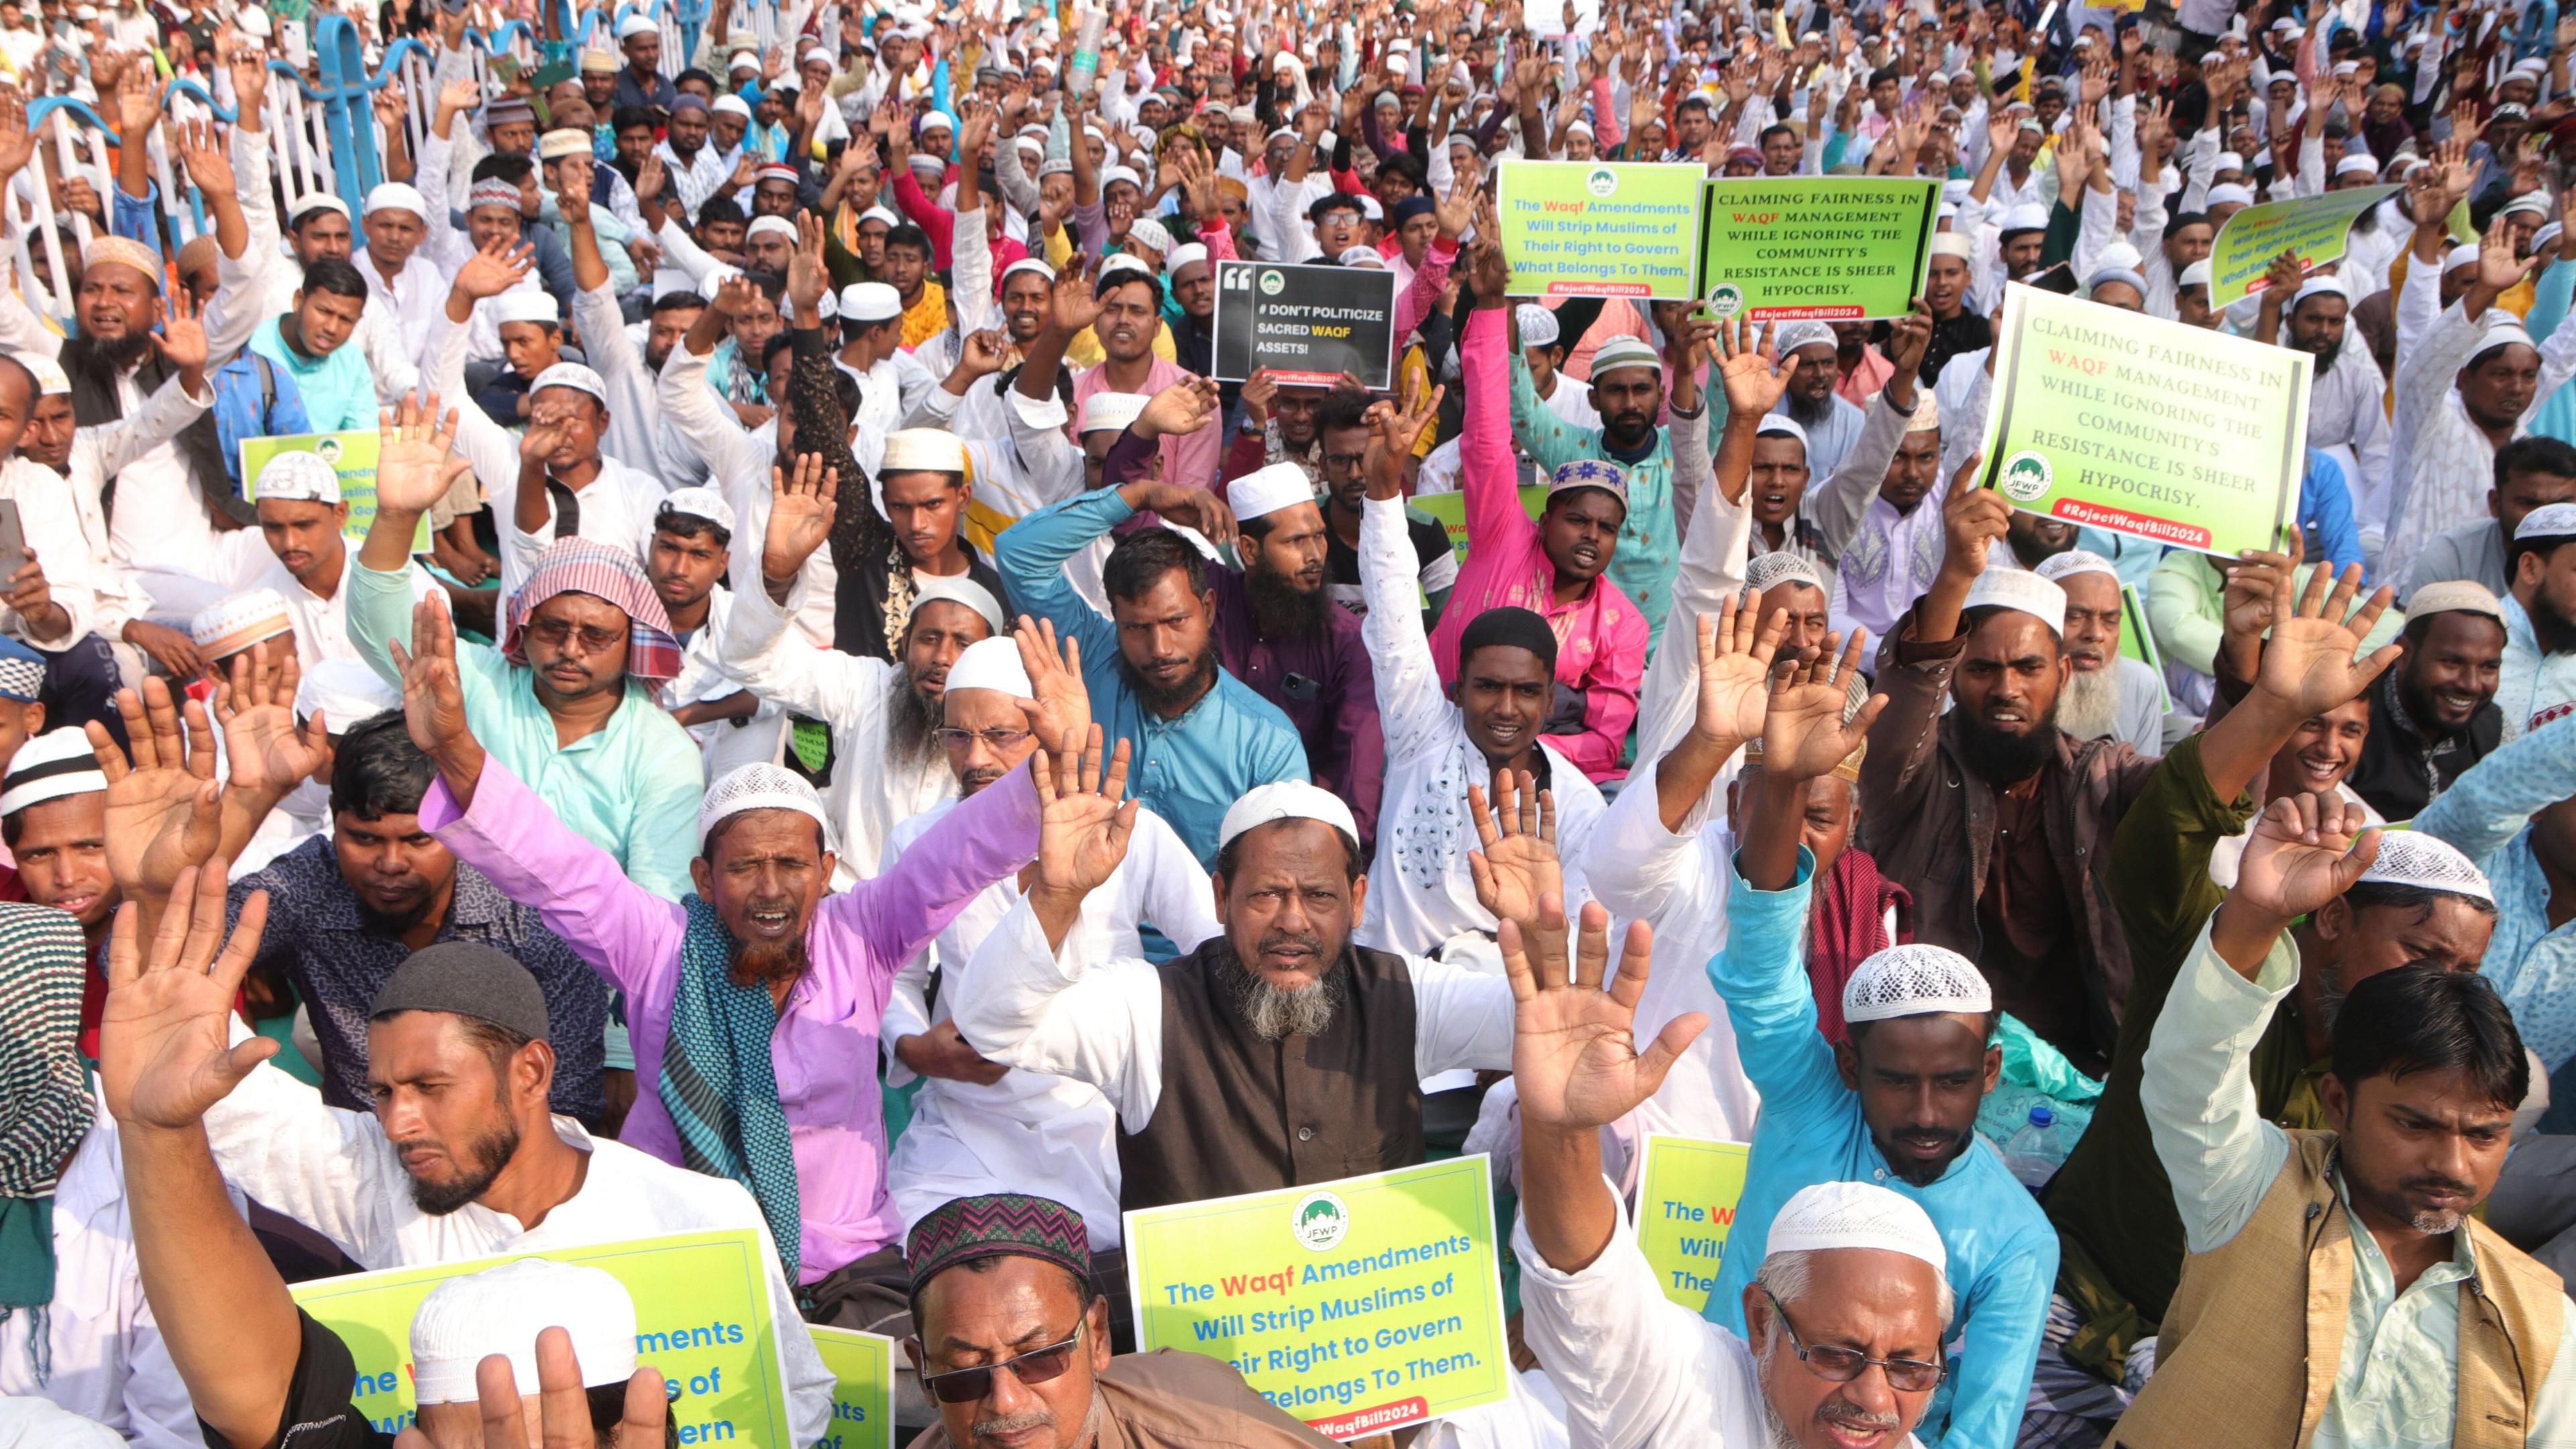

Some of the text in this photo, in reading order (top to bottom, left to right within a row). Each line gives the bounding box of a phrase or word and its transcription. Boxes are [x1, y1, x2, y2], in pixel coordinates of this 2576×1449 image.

[1514, 199, 1690, 215] The Waqf Amendments
[1718, 193, 1920, 206] CLAIMING FAIRNESS IN
[1527, 220, 1677, 235] Will Strip Muslims of
[1733, 211, 1902, 225] WAQF MANAGEMENT
[1728, 229, 1902, 241] WHILE IGNORING THE
[1523, 240, 1679, 256] Their Right to Govern
[1756, 247, 1868, 259] COMMUNITY'S
[1513, 261, 1688, 278] What Belongs To Them.
[1724, 265, 1896, 278] RESISTANCE IS SHEER
[1762, 284, 1854, 297] HYPOCRISY.
[1258, 303, 1383, 321] # DON'T POLITICIZE
[1754, 307, 1858, 319] #RejectWaqfBill2024
[1257, 322, 1351, 338] SACRED WAQF
[1256, 341, 1309, 355] ASSETS!
[2032, 317, 2283, 388] CLAIMING FAIRNESS IN
[2049, 348, 2261, 411] WAQF MANAGEMENT
[2041, 374, 2263, 440] WHILE IGNORING THE
[2078, 411, 2220, 458] COMMUNITY'S
[2032, 429, 2160, 472] RESISTANCE
[2167, 459, 2186, 477] IS
[2192, 466, 2257, 494] SHEER
[2009, 480, 2039, 491] JFWP
[2079, 470, 2202, 510] HYPOCRISY.
[1446, 524, 1466, 533] Wa
[2061, 502, 2204, 544] #RejectWaqfBill2024
[1663, 1201, 1705, 1222] The
[1307, 1226, 1338, 1239] JFWP
[1680, 1237, 1724, 1259] Will
[1164, 1235, 1471, 1305] The Waqf Amendments
[1671, 1271, 1714, 1293] The
[1193, 1272, 1454, 1342] Will Strip Muslims of
[1268, 1340, 1339, 1373] Right
[1344, 1337, 1369, 1356] to
[1375, 1316, 1462, 1349] Govern
[354, 1371, 398, 1397] he
[635, 1321, 744, 1354] ments
[690, 1366, 721, 1395] of
[1371, 1368, 1401, 1389] To
[1405, 1352, 1481, 1381] Them.
[1316, 1403, 1419, 1436] WaqfBill2024
[678, 1419, 735, 1445] ern
